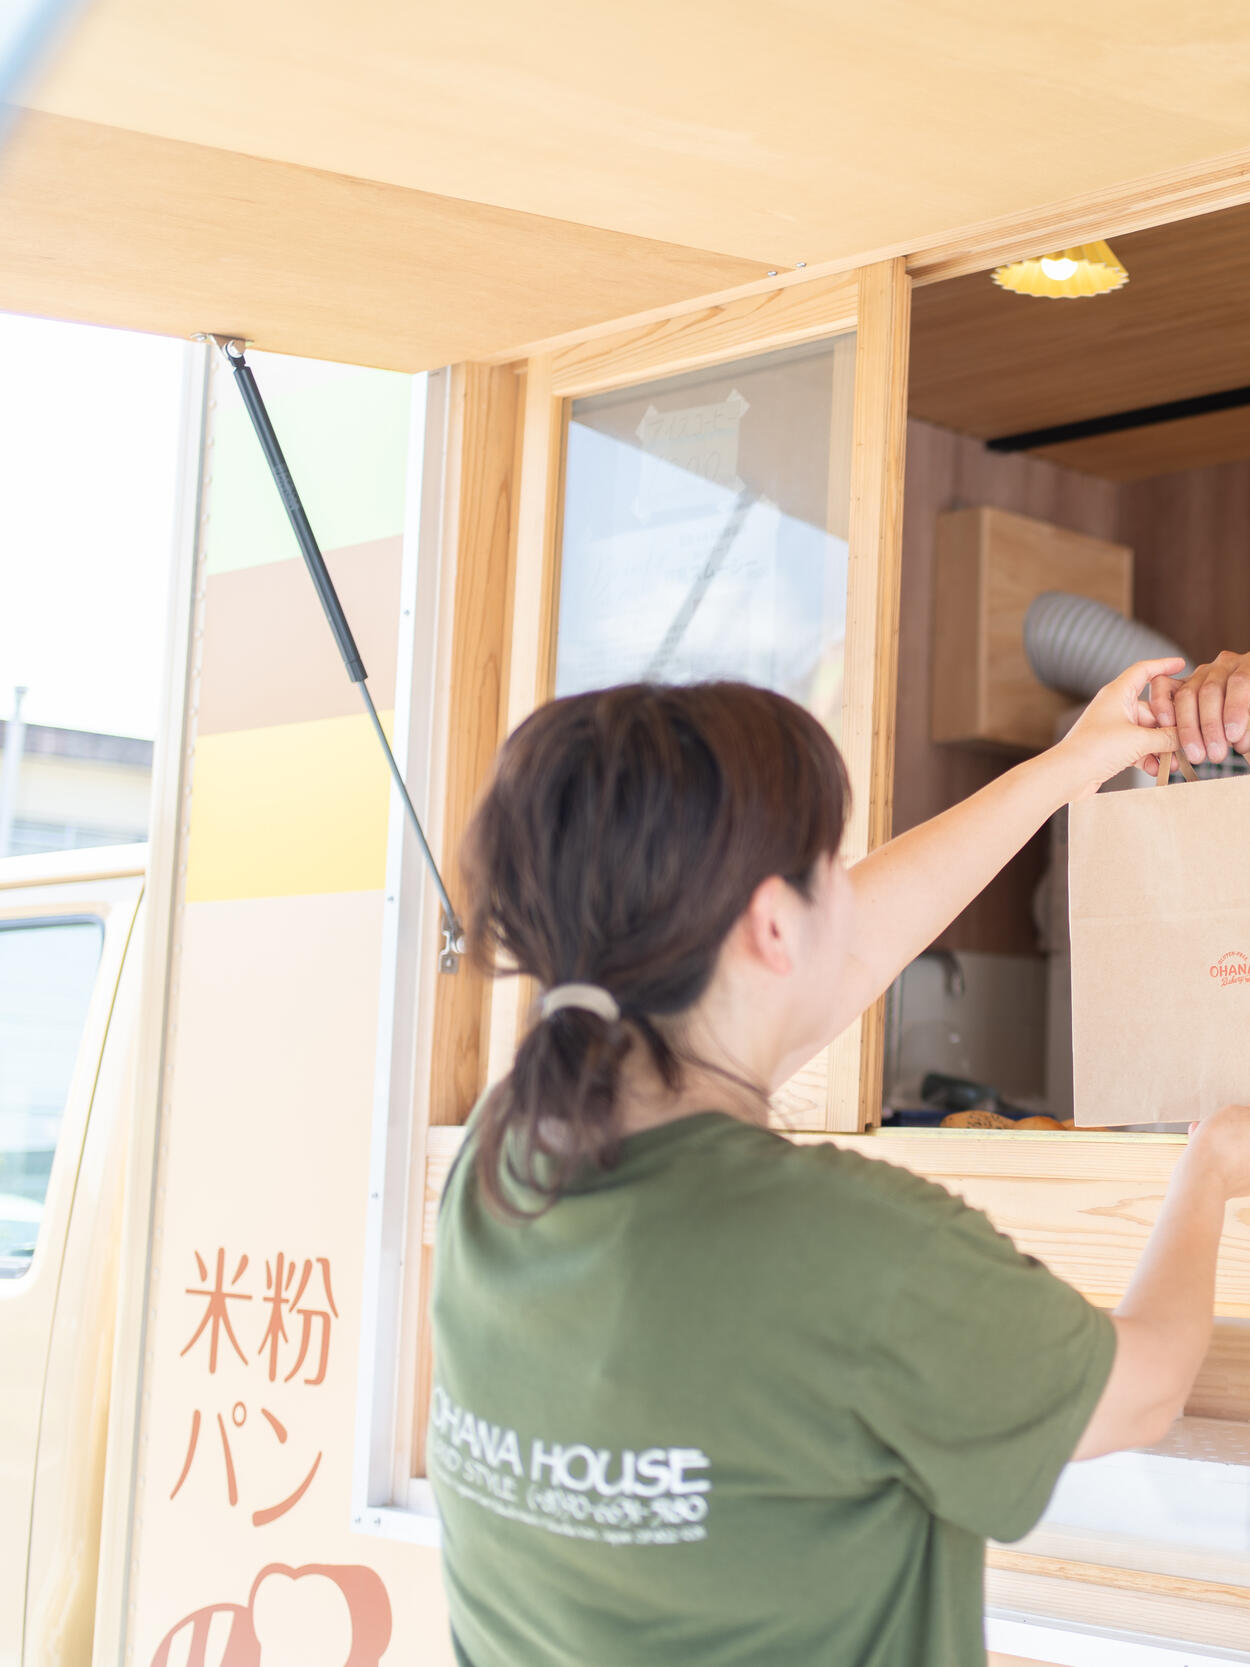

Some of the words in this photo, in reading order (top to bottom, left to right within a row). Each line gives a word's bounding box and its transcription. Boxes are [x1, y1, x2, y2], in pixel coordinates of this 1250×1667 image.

[180, 1247, 339, 1386] 米粉
[170, 1401, 322, 1527] パン
[431, 1385, 525, 1478] OHANA
[530, 1437, 712, 1498] HOUSE
